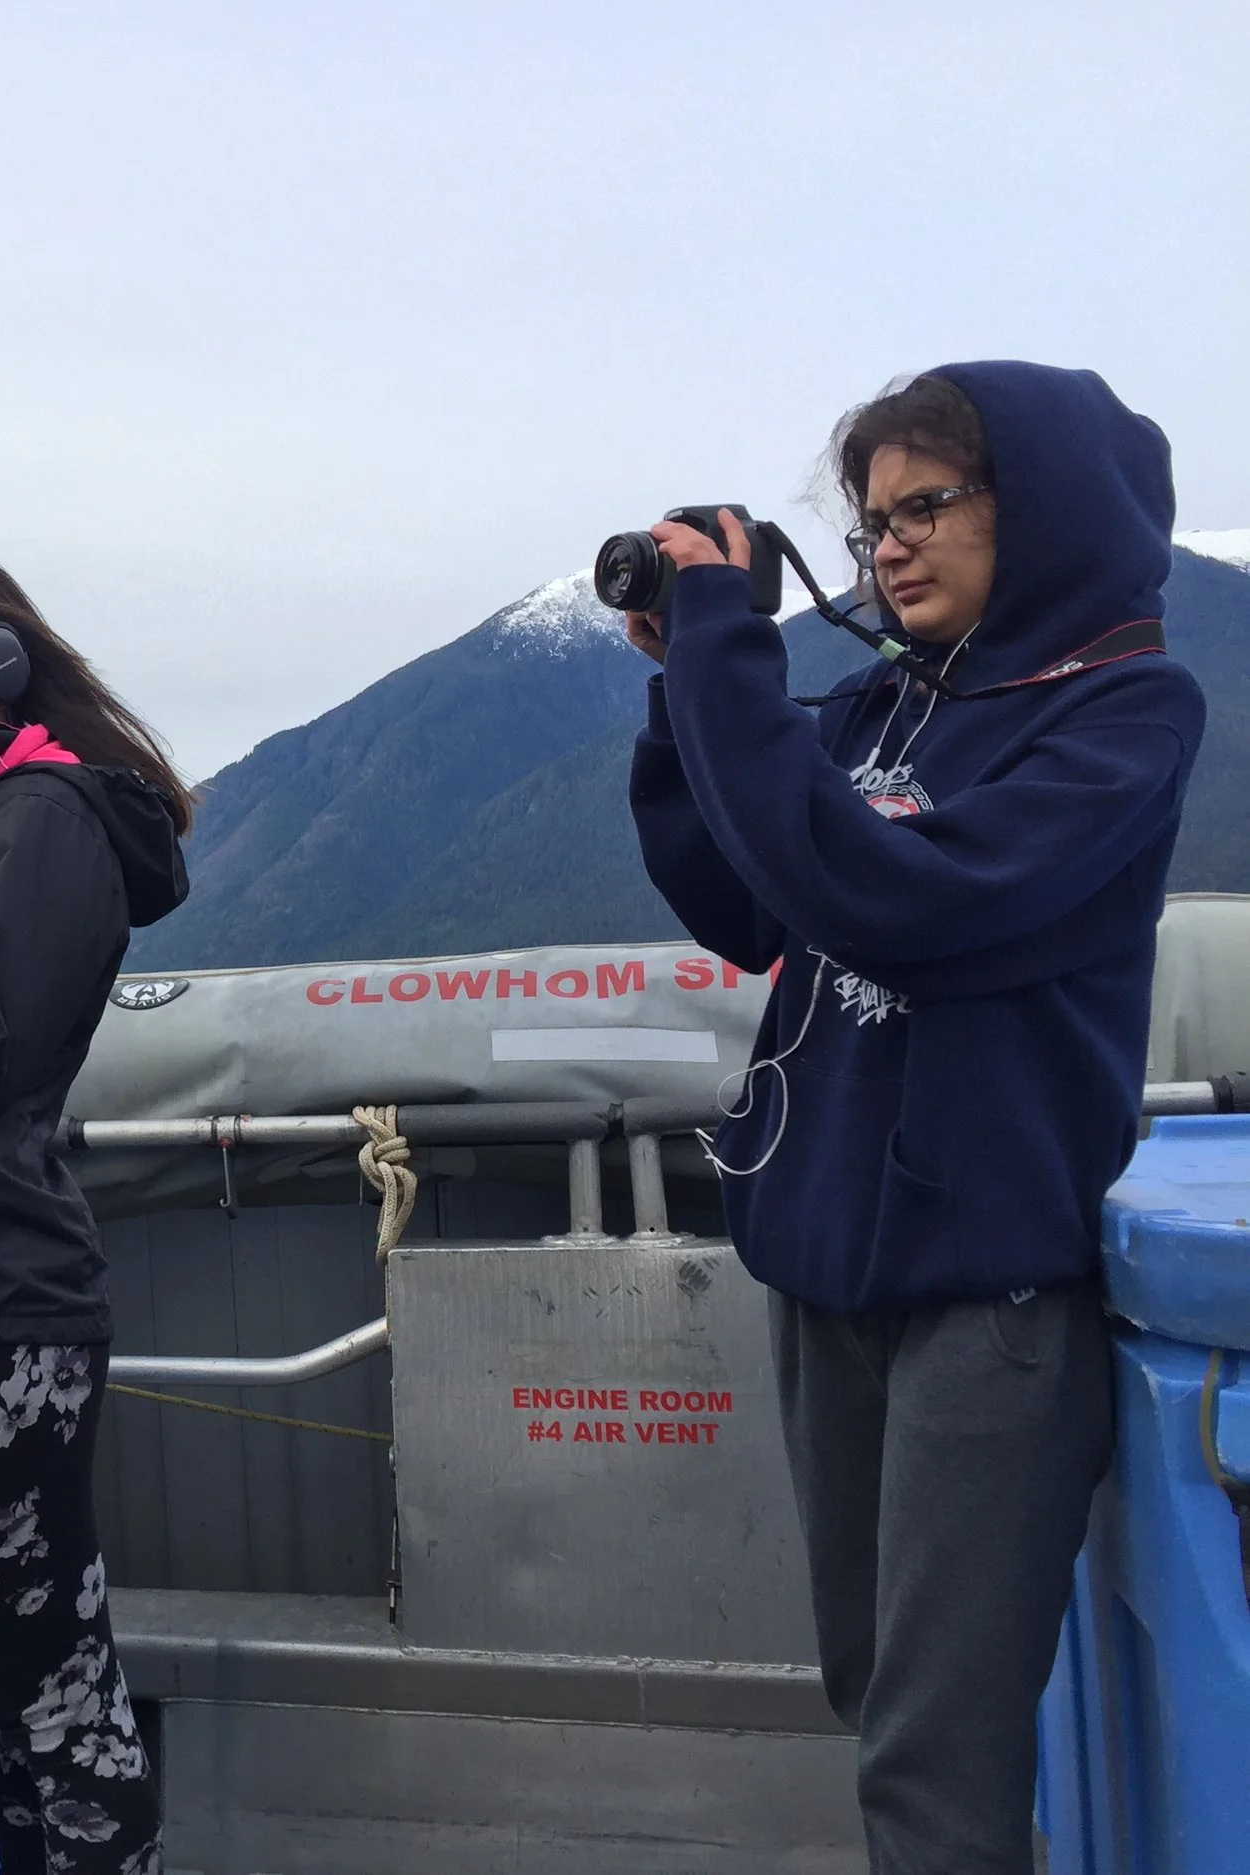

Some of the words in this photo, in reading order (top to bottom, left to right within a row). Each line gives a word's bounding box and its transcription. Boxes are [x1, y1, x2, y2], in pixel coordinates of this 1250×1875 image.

[306, 961, 646, 1006] CLOWHOM
[512, 1387, 629, 1411] ENGINE
[639, 1390, 733, 1413] ROOM
[527, 1420, 563, 1442] #4
[573, 1421, 627, 1443] AIR
[634, 1422, 720, 1444] VENT
